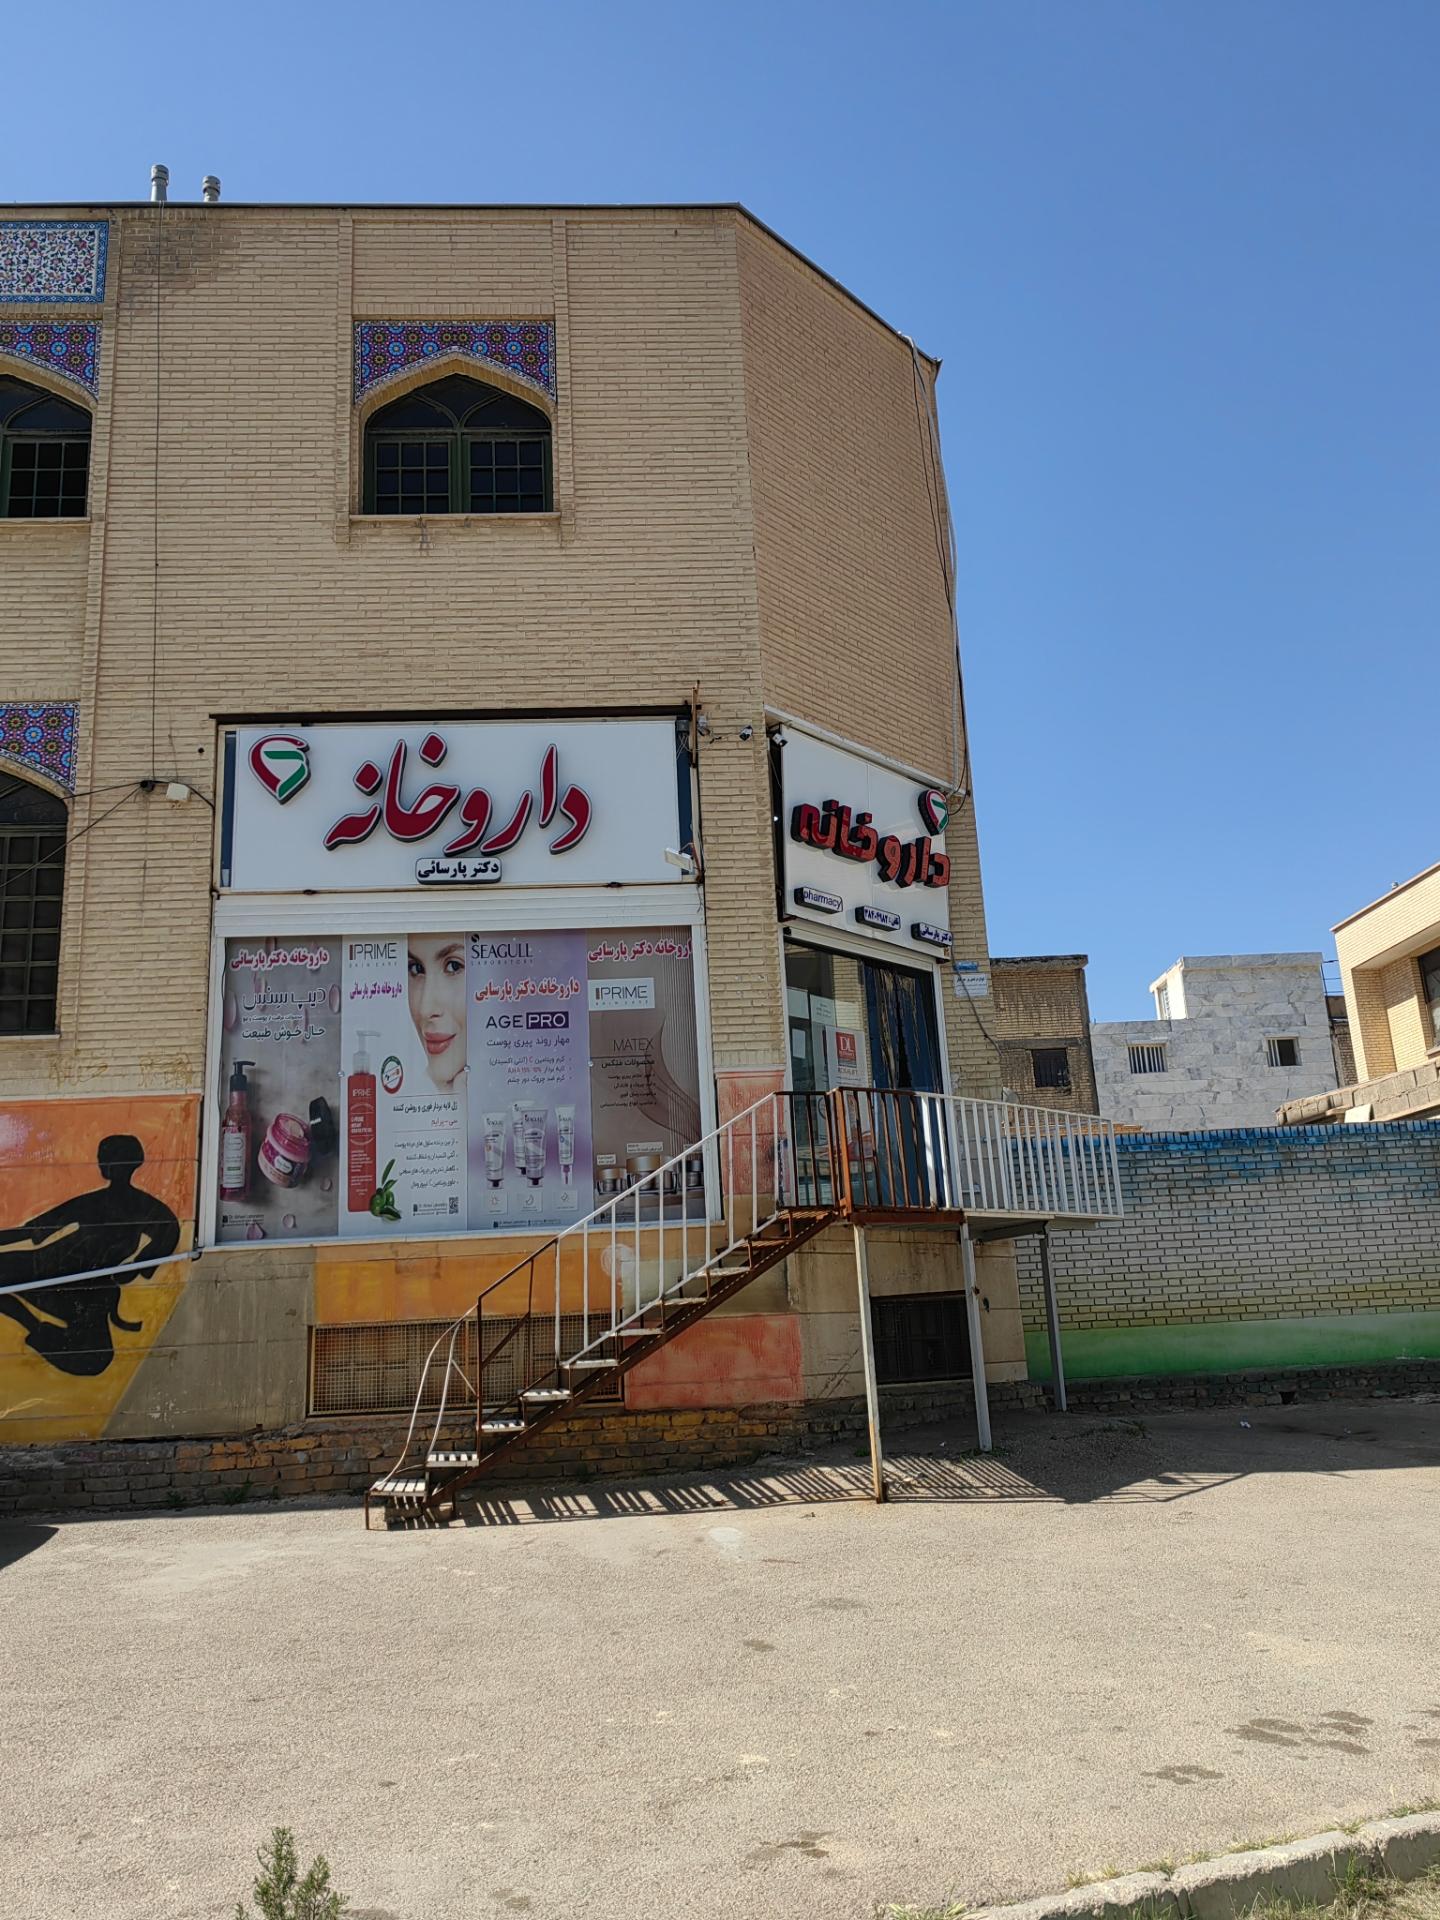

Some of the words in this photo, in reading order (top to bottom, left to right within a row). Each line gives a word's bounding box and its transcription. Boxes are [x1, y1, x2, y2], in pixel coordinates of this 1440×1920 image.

[323, 731, 592, 856] داروخانه
[790, 799, 950, 888] داروخانه
[470, 860, 499, 877] دکتر
[803, 890, 842, 910] pharmacy
[941, 932, 952, 943] دکتر
[471, 943, 533, 959] SEAGULL
[629, 940, 653, 960] دکتر
[655, 939, 692, 958] اروخانه
[267, 950, 288, 969] دکتر
[289, 949, 329, 967] داروخانه
[369, 981, 380, 999] دکتر
[382, 981, 402, 998] داروخانه
[515, 979, 536, 1000] دکتر
[538, 977, 580, 999] داروخانه
[291, 987, 326, 1010] دیپ
[486, 1014, 523, 1029] AGE
[528, 1013, 566, 1029] PRO
[242, 1027, 271, 1040] طبیعت
[274, 1026, 301, 1040] خوش
[304, 1025, 325, 1039] حال
[554, 1034, 570, 1047] مهار
[486, 1039, 511, 1049] پوست
[514, 1039, 533, 1048] پیری
[536, 1037, 551, 1047] روند
[613, 1038, 654, 1051] MATEX
[840, 1036, 854, 1052] DL
